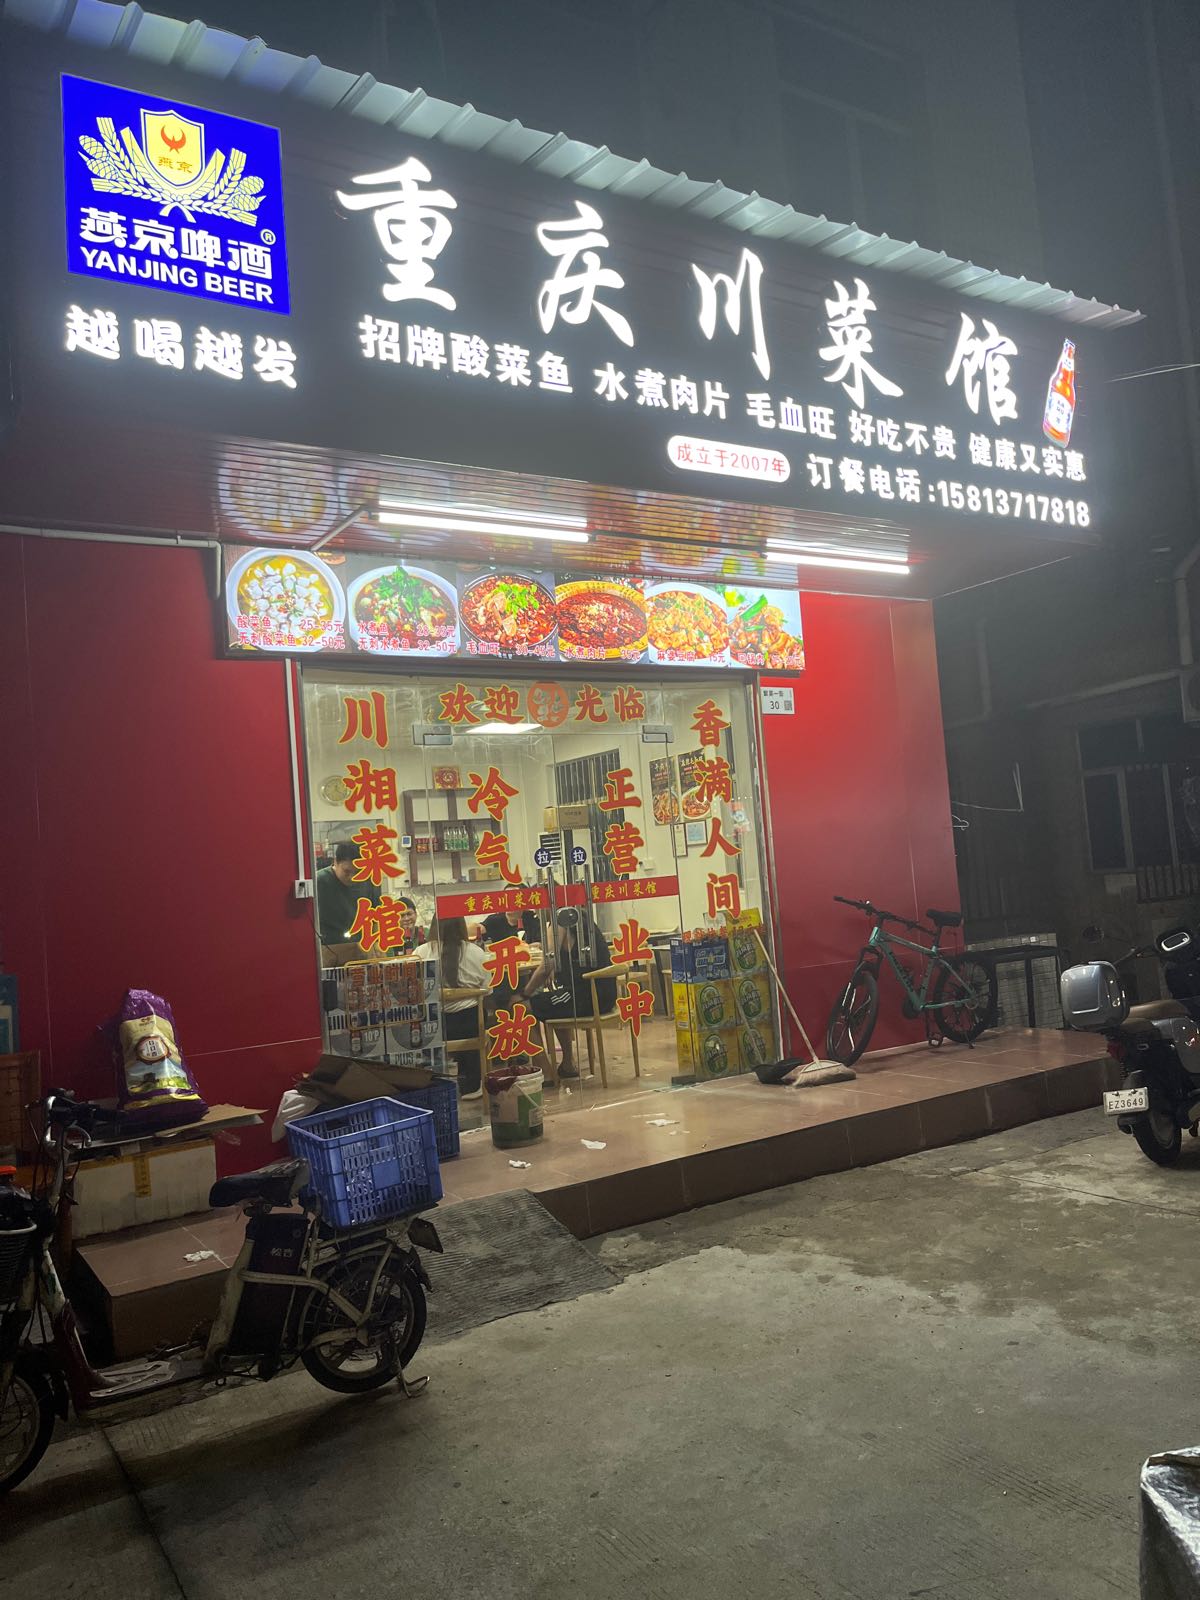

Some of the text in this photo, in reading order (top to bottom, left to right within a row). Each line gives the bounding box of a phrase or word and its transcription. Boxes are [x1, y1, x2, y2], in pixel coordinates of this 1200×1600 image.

[158, 156, 193, 174] 燕京
[79, 207, 273, 280] 燕京啤酒
[79, 246, 274, 304] YANJING BEER
[336, 155, 1019, 426] 重庆川菜馆
[64, 304, 298, 389] 越喝越发
[358, 313, 1088, 482] 招牌酸菜鱼 水煮肉片 毛血旺 好吃不贵 健康又实惠
[676, 443, 788, 477] 成立于2007年
[236, 615, 272, 630] 酸菜鱼
[357, 621, 389, 635] 水煮鱼
[238, 632, 346, 650] 无刺酸菜鱼 32-50元
[358, 637, 411, 651] 无刺水煮鱼
[438, 683, 526, 725] 欢迎
[574, 683, 646, 724] 光临
[770, 700, 780, 710] 30
[338, 690, 407, 953] 川湘菜馆
[689, 699, 743, 919] 香满人间
[537, 850, 550, 865] 拉
[573, 849, 585, 863] 拉
[464, 891, 542, 913] 重庆川菜馆
[591, 881, 658, 901] 重庆川菜馆
[599, 767, 656, 1039] 正营业中
[467, 766, 544, 1061] 冷气开放
[1108, 1097, 1144, 1110] EZ3649
